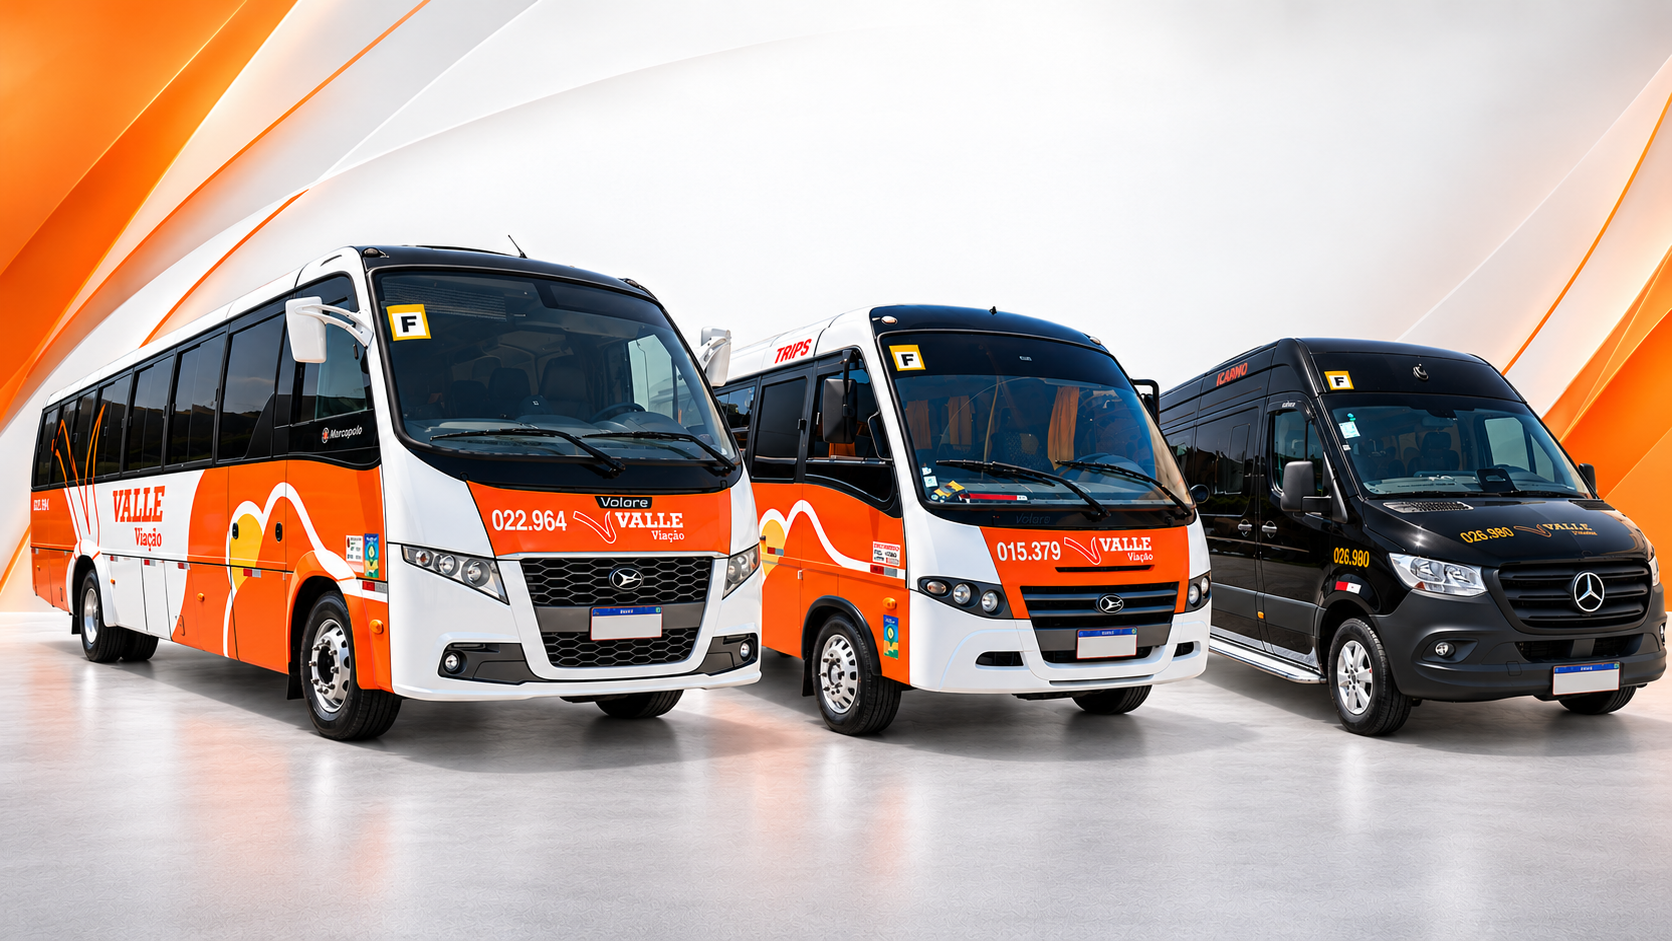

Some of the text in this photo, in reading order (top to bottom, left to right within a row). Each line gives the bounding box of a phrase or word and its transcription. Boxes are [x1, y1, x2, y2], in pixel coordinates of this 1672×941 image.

[401, 315, 417, 333] F
[774, 338, 812, 364] TRIPS
[901, 353, 914, 366] F
[1334, 377, 1345, 386] F
[330, 425, 363, 439] Marcopolo
[112, 485, 166, 523] VALLE
[491, 509, 567, 532] 022.964
[615, 512, 684, 528] VALLE
[134, 527, 162, 552] Viação
[651, 530, 685, 543] Viação
[1098, 537, 1152, 551] VALLE
[1460, 526, 1515, 544] 026.980
[996, 541, 1061, 561] 015.379
[1333, 547, 1370, 568] 026.980
